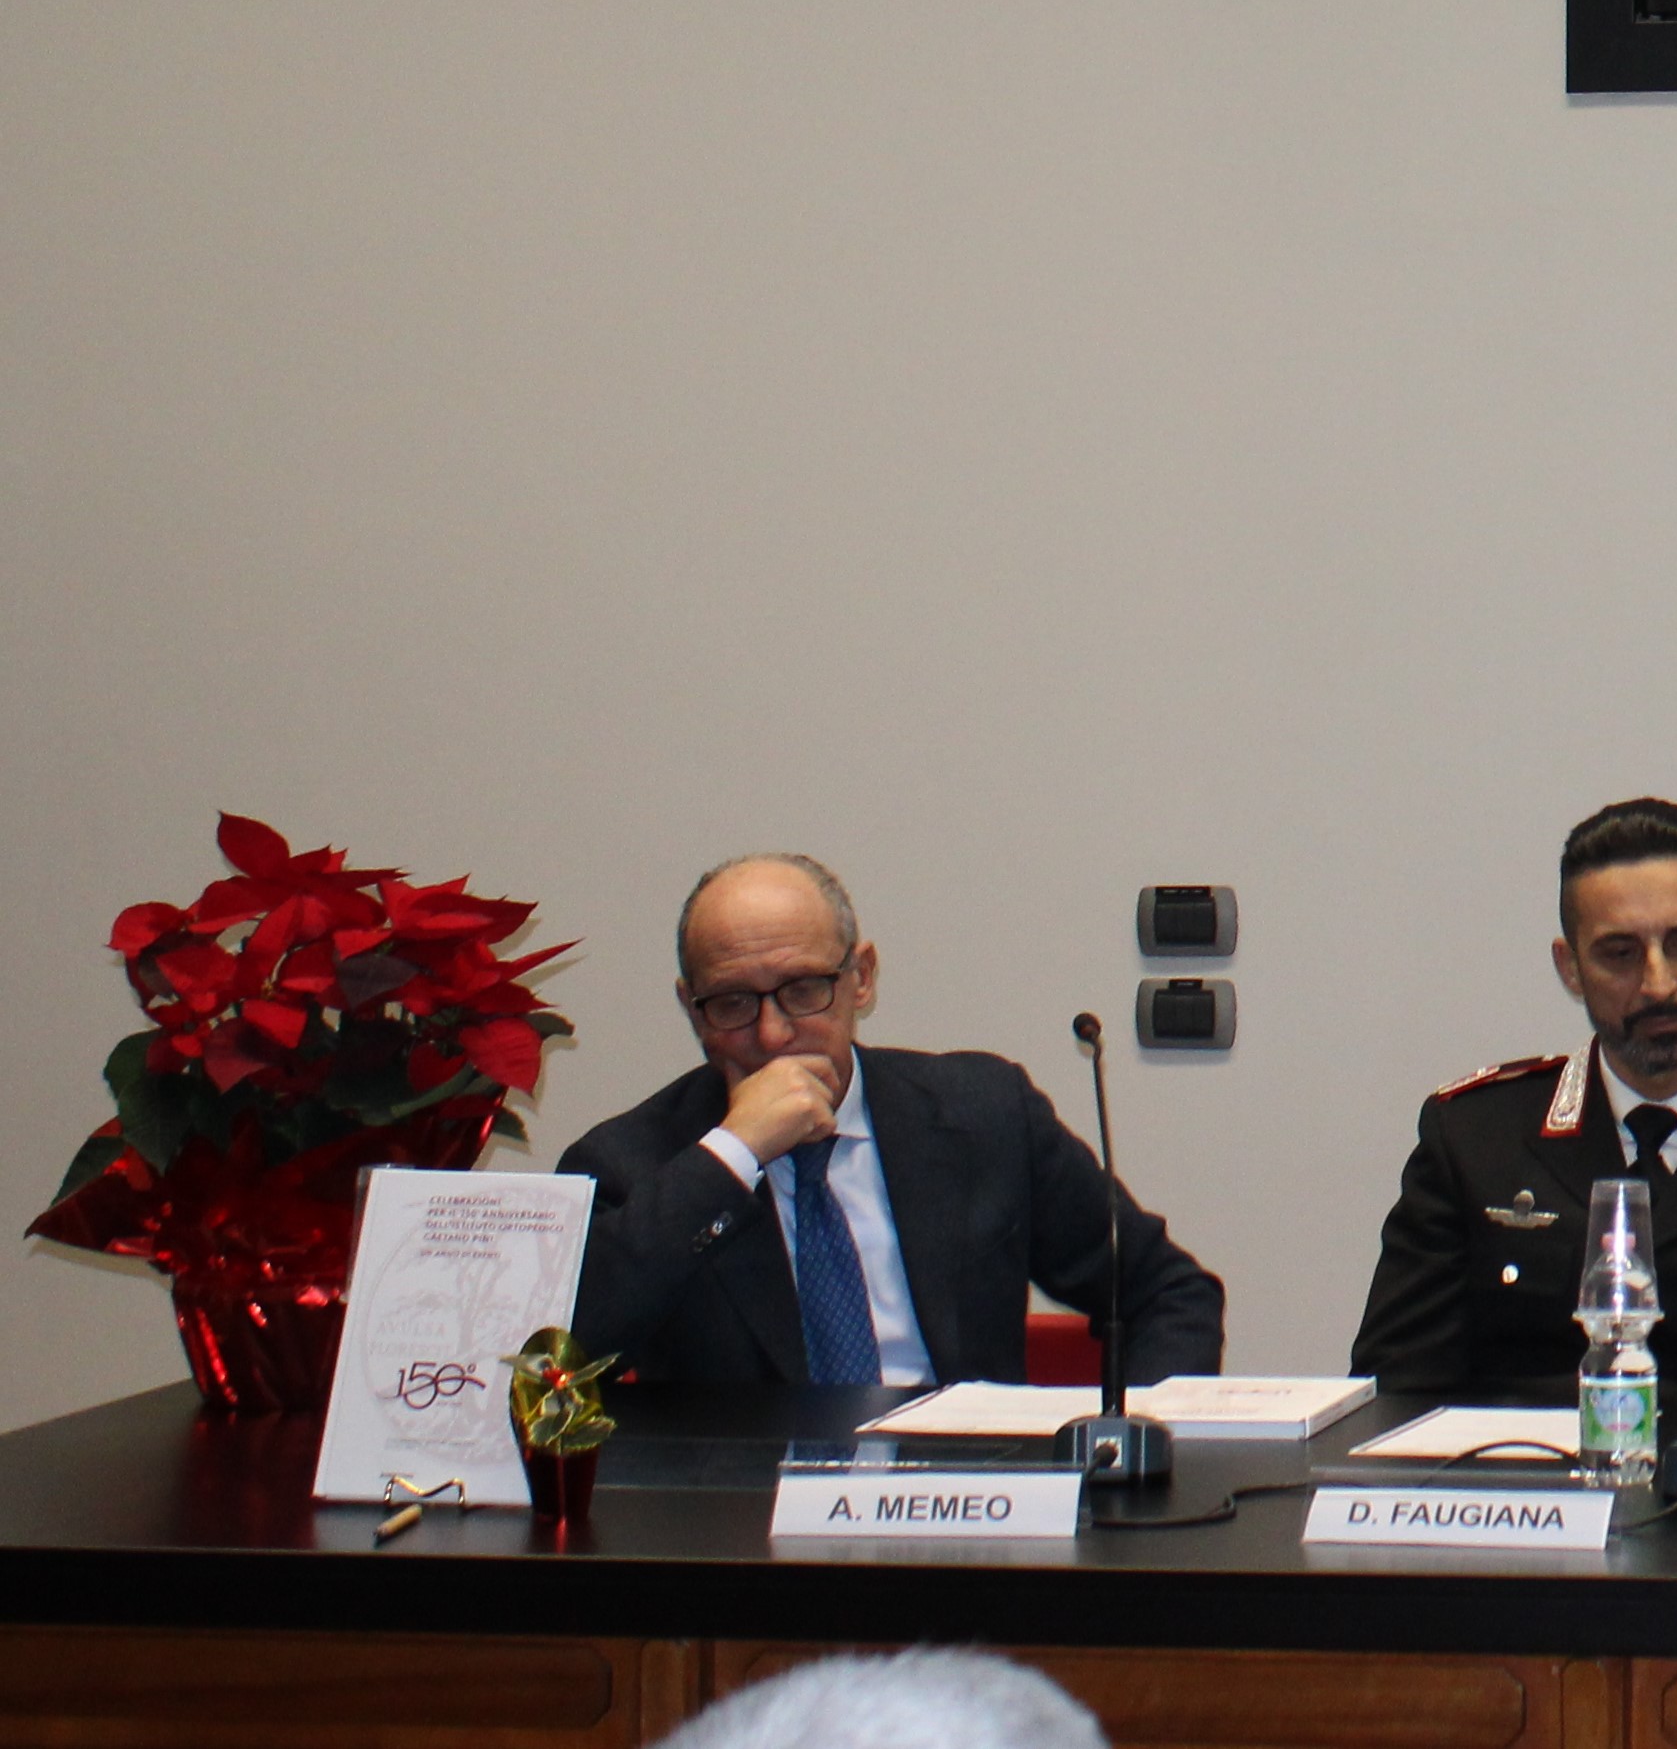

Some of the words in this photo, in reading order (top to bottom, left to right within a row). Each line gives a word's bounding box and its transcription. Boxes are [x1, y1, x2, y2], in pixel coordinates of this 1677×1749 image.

[827, 1495, 863, 1521] A.
[875, 1495, 1013, 1521] MEMEO
[1347, 1501, 1379, 1525] D.
[1390, 1502, 1565, 1529] FAUGIANA
